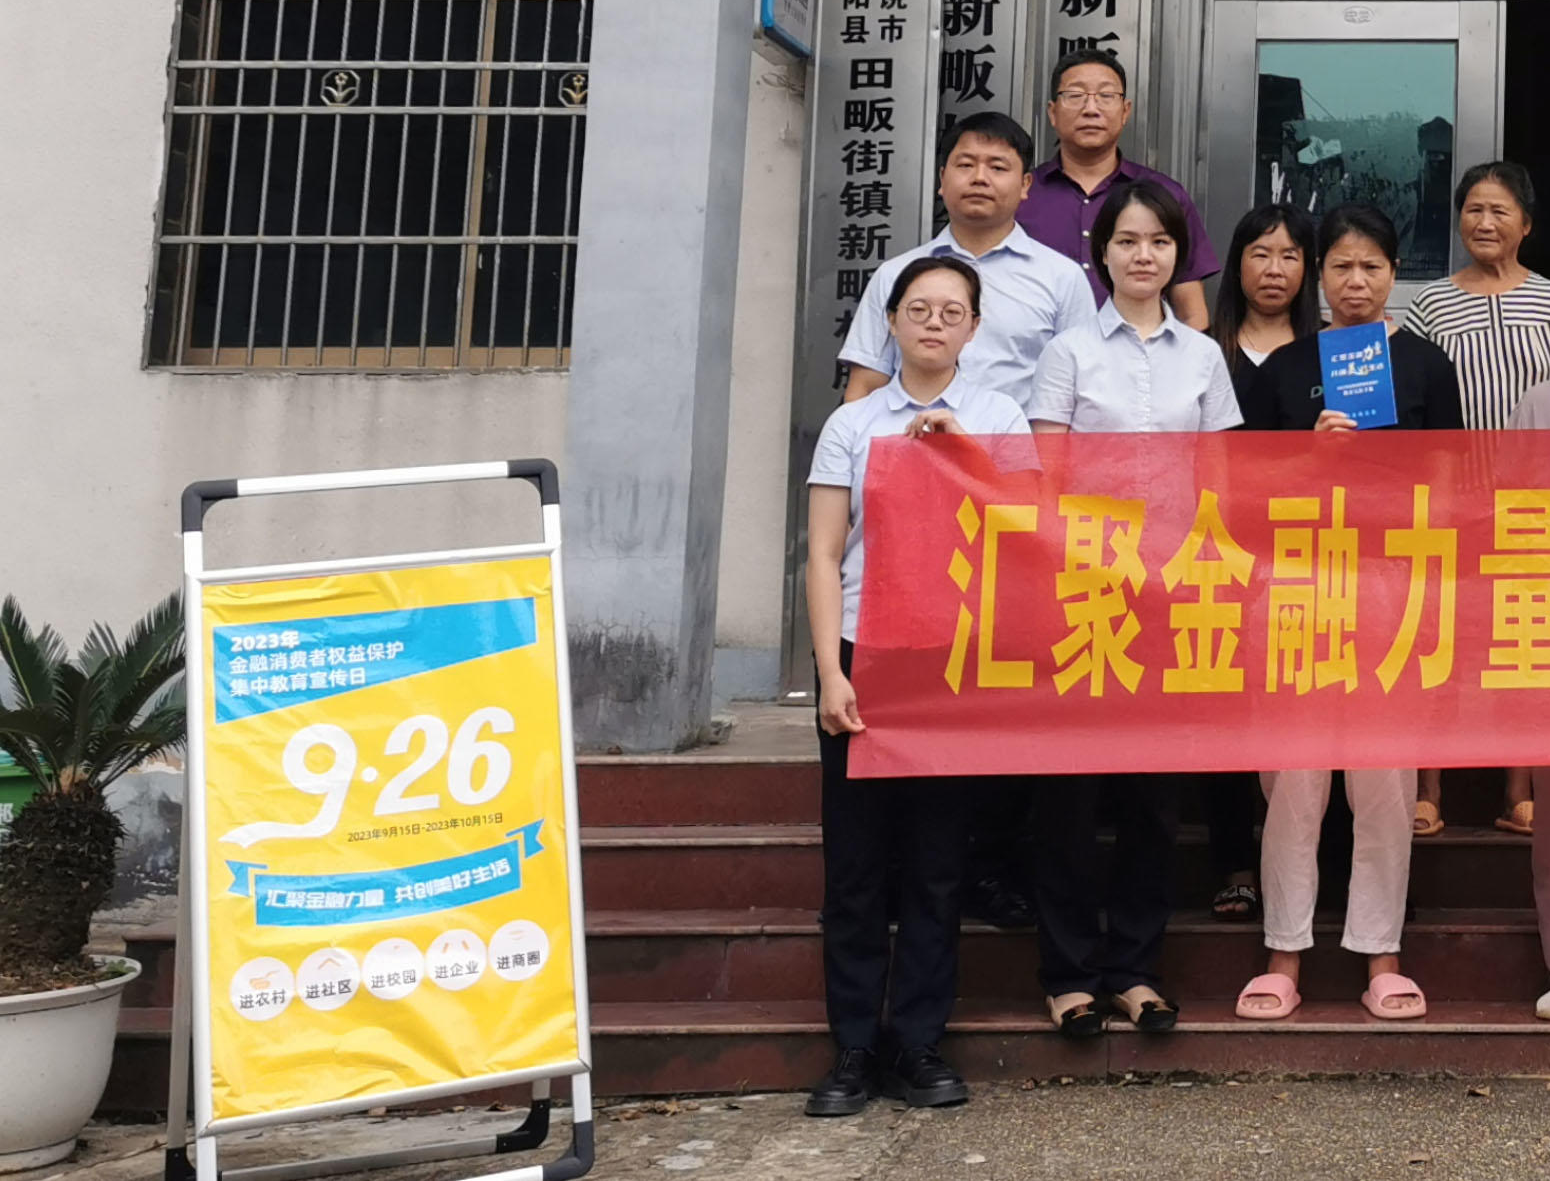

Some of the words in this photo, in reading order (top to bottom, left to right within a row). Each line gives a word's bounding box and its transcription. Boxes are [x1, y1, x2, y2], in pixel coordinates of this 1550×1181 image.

[230, 630, 300, 653] 2023年
[228, 641, 405, 675] 金融消费者权益保护
[229, 667, 366, 698] 集中教育宣传日
[347, 813, 504, 843] 2023年9月15日-2023年10月15日
[265, 889, 385, 910] 汇聚金融力量
[395, 858, 511, 904] 共创美好生活
[434, 960, 480, 980] 进企业
[496, 951, 541, 970] 进商圈
[305, 979, 352, 1000] 进社区
[370, 970, 417, 990] 进校园
[239, 989, 286, 1010] 进农村
